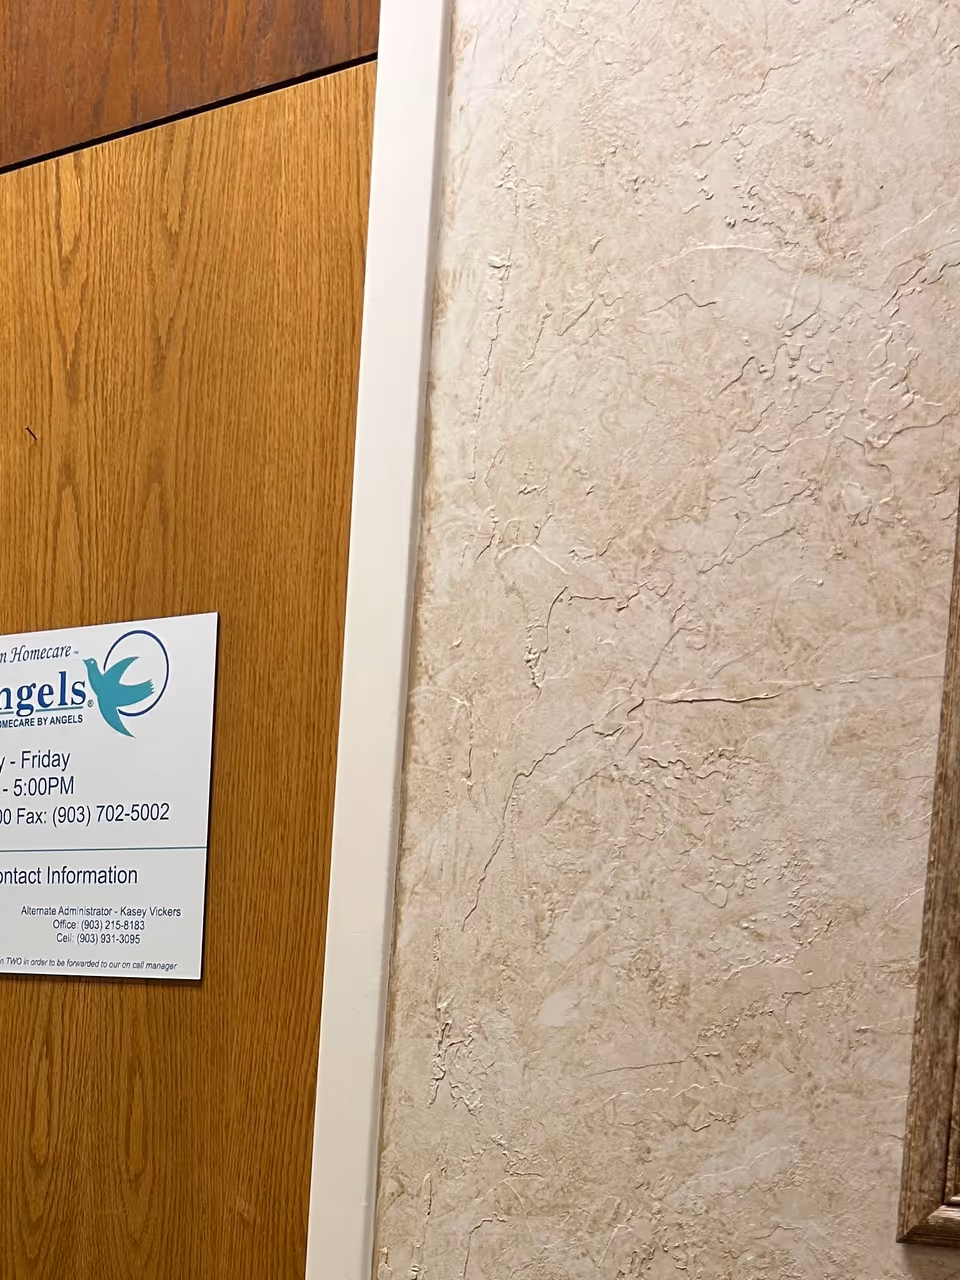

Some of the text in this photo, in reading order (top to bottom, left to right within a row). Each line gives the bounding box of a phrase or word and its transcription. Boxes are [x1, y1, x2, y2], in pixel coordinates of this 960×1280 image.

[10, 644, 72, 663] Homecare
[37, 717, 49, 726] BY
[50, 714, 83, 725] ANGELS
[21, 750, 70, 772] Friday
[13, 775, 74, 797] 5:00PM
[17, 807, 47, 825] Fax:
[52, 805, 91, 827] (903)
[96, 802, 170, 823] 702-5002
[46, 865, 138, 885] Information
[21, 906, 57, 916] Alternate
[58, 906, 112, 916] Administrator
[120, 906, 147, 918] Kasey
[149, 906, 181, 917] Vickers
[53, 919, 145, 932] Office: (903) 215-8183
[56, 933, 141, 945] Cell: (903) 931-3095
[6, 957, 22, 965] TWO
[23, 957, 29, 965] in
[30, 958, 47, 966] order
[48, 958, 55, 966] to
[56, 959, 65, 967] be
[66, 959, 99, 968] forwarded
[100, 960, 108, 968] to
[109, 961, 120, 969] our
[132, 961, 144, 969] call
[145, 962, 178, 971] manager
